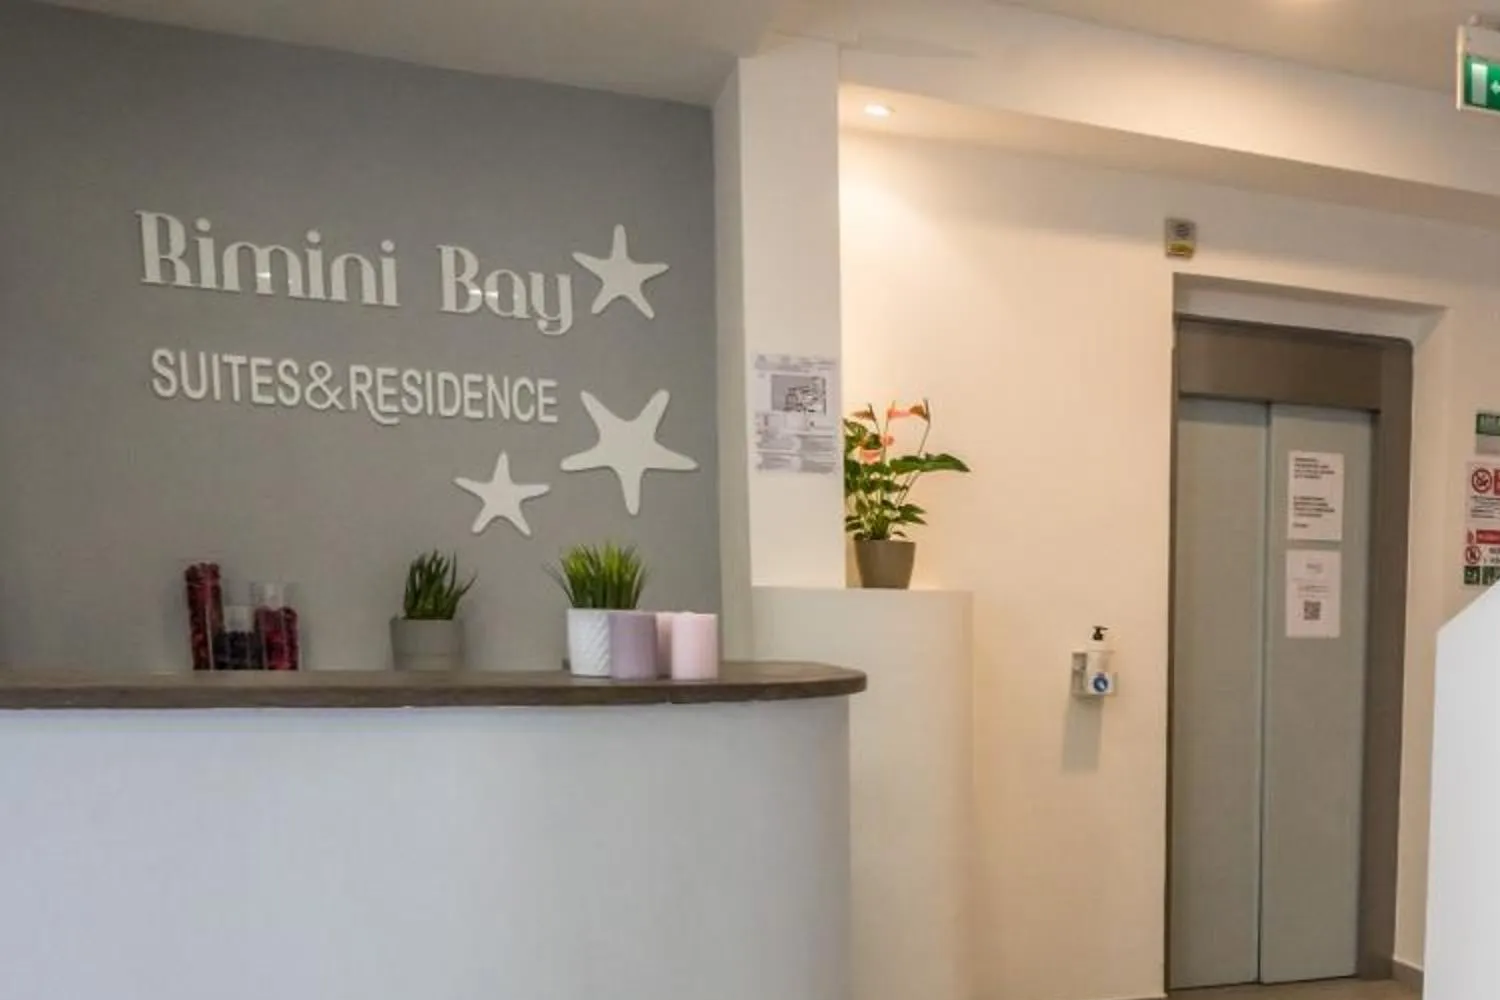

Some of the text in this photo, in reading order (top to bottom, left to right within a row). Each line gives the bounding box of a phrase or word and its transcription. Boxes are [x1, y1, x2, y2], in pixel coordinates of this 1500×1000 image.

[135, 210, 573, 335] Rimini Bay
[151, 348, 559, 425] SUITES&RESIDENCE
